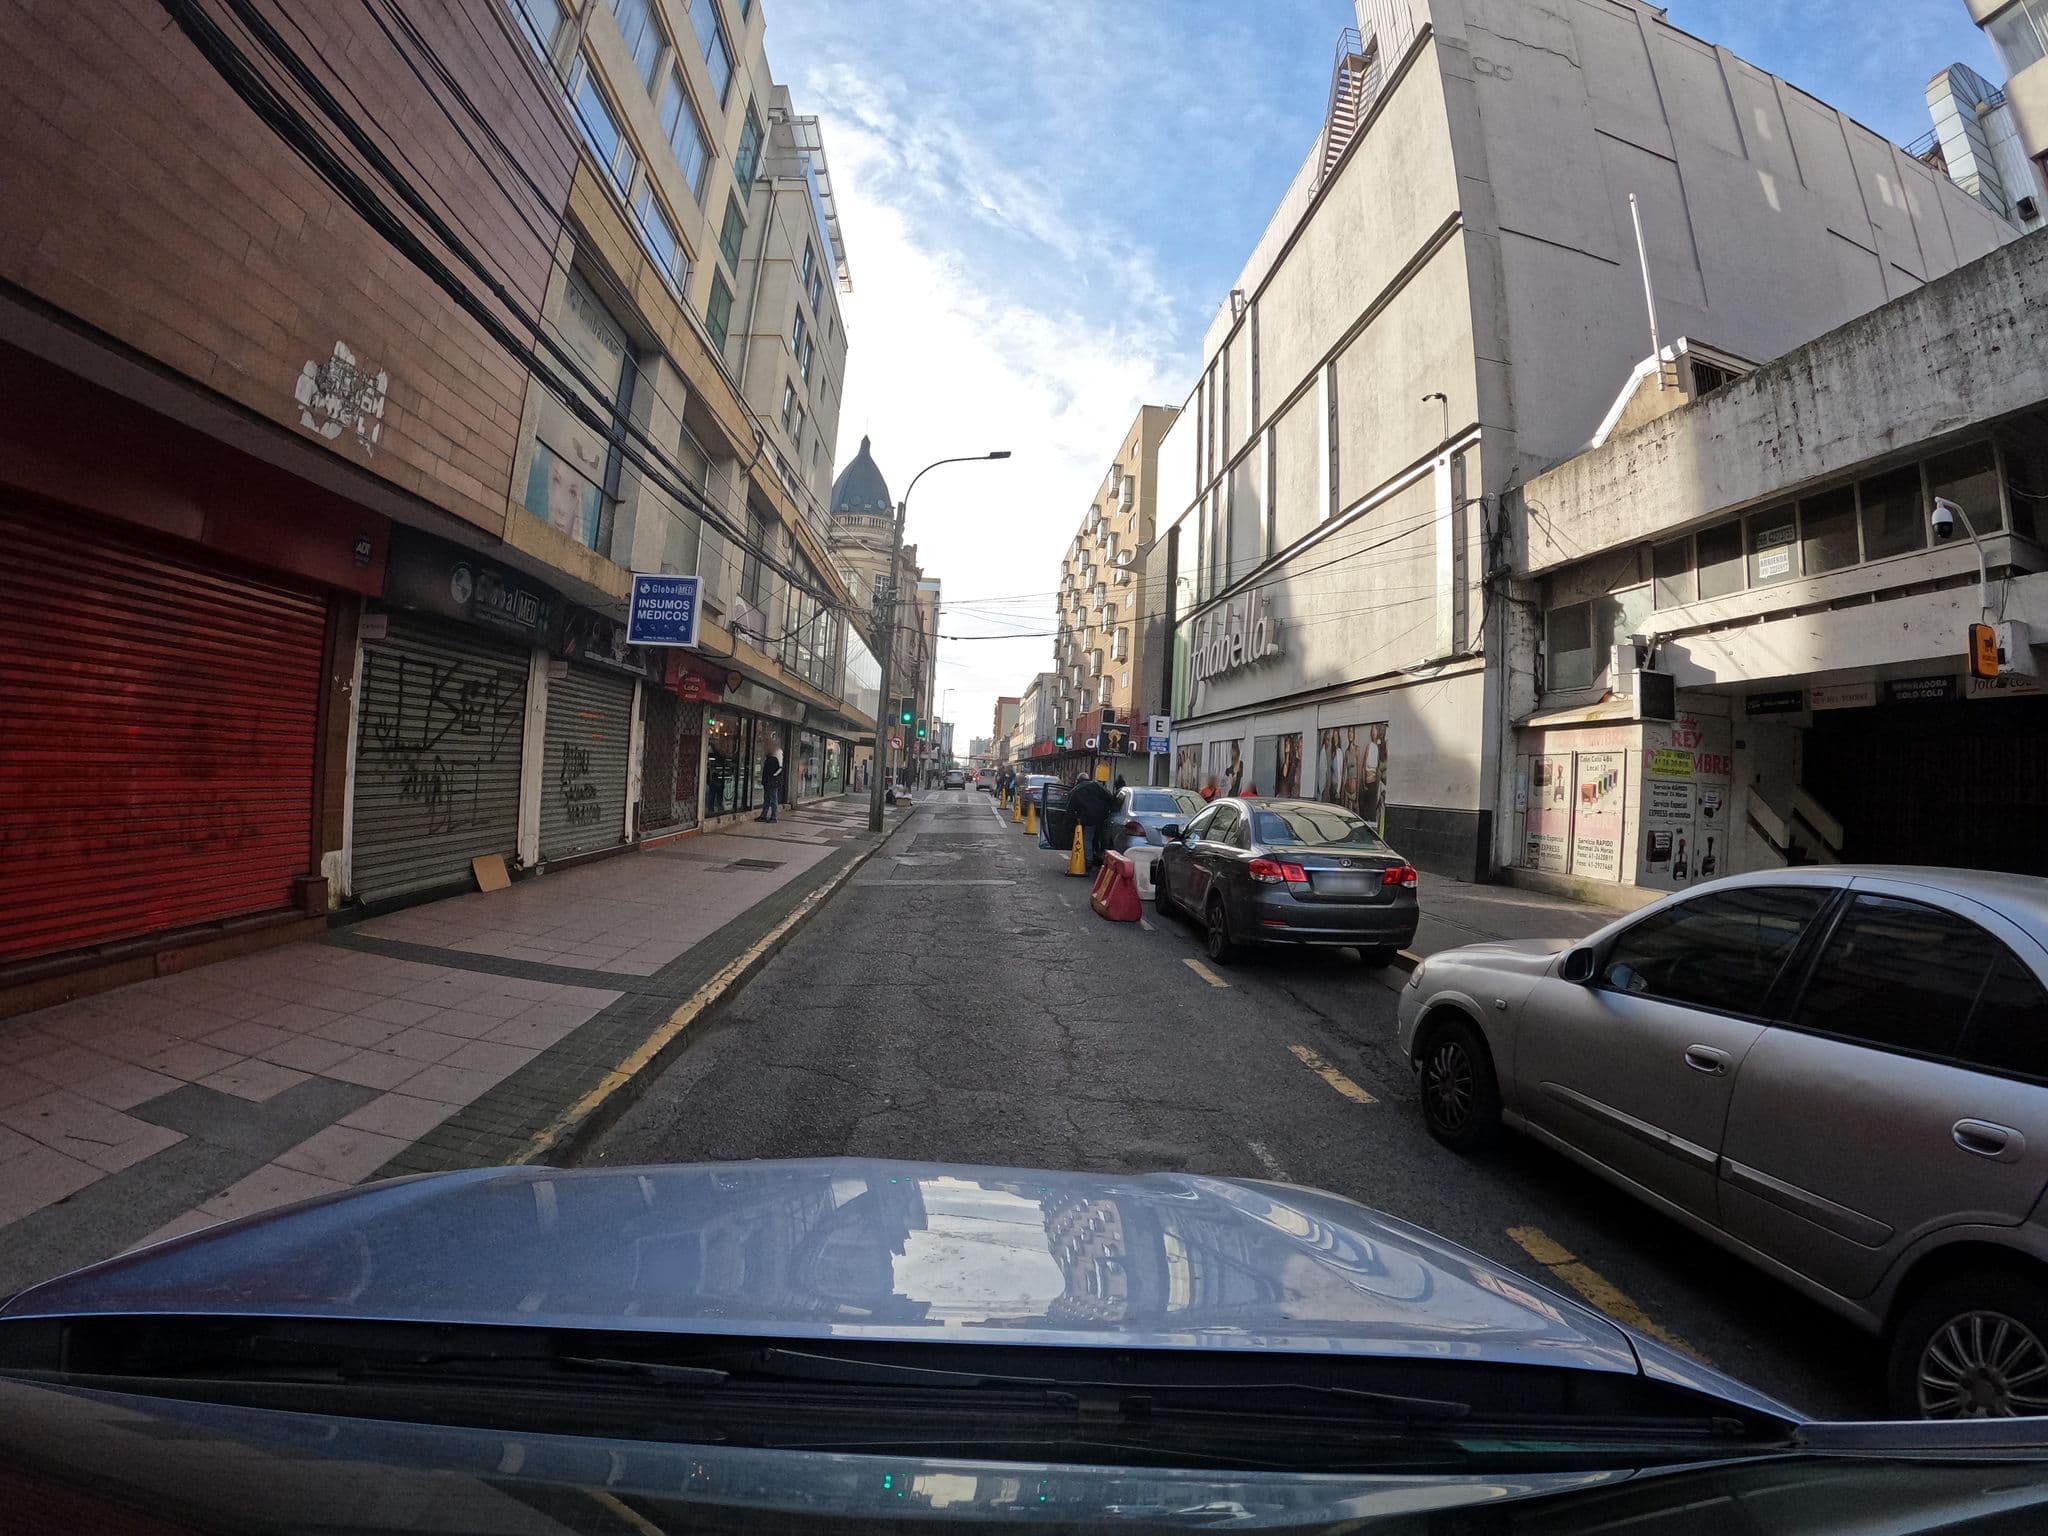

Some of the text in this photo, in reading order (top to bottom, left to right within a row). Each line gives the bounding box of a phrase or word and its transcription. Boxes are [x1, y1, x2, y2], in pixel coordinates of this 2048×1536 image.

[638, 598, 691, 611] INSUMOS
[637, 610, 689, 621] MEDICOS
[1156, 720, 1164, 733] E
[1671, 729, 1703, 749] REY
[1693, 751, 1730, 776] MBRE
[1578, 837, 1595, 845] Servicio
